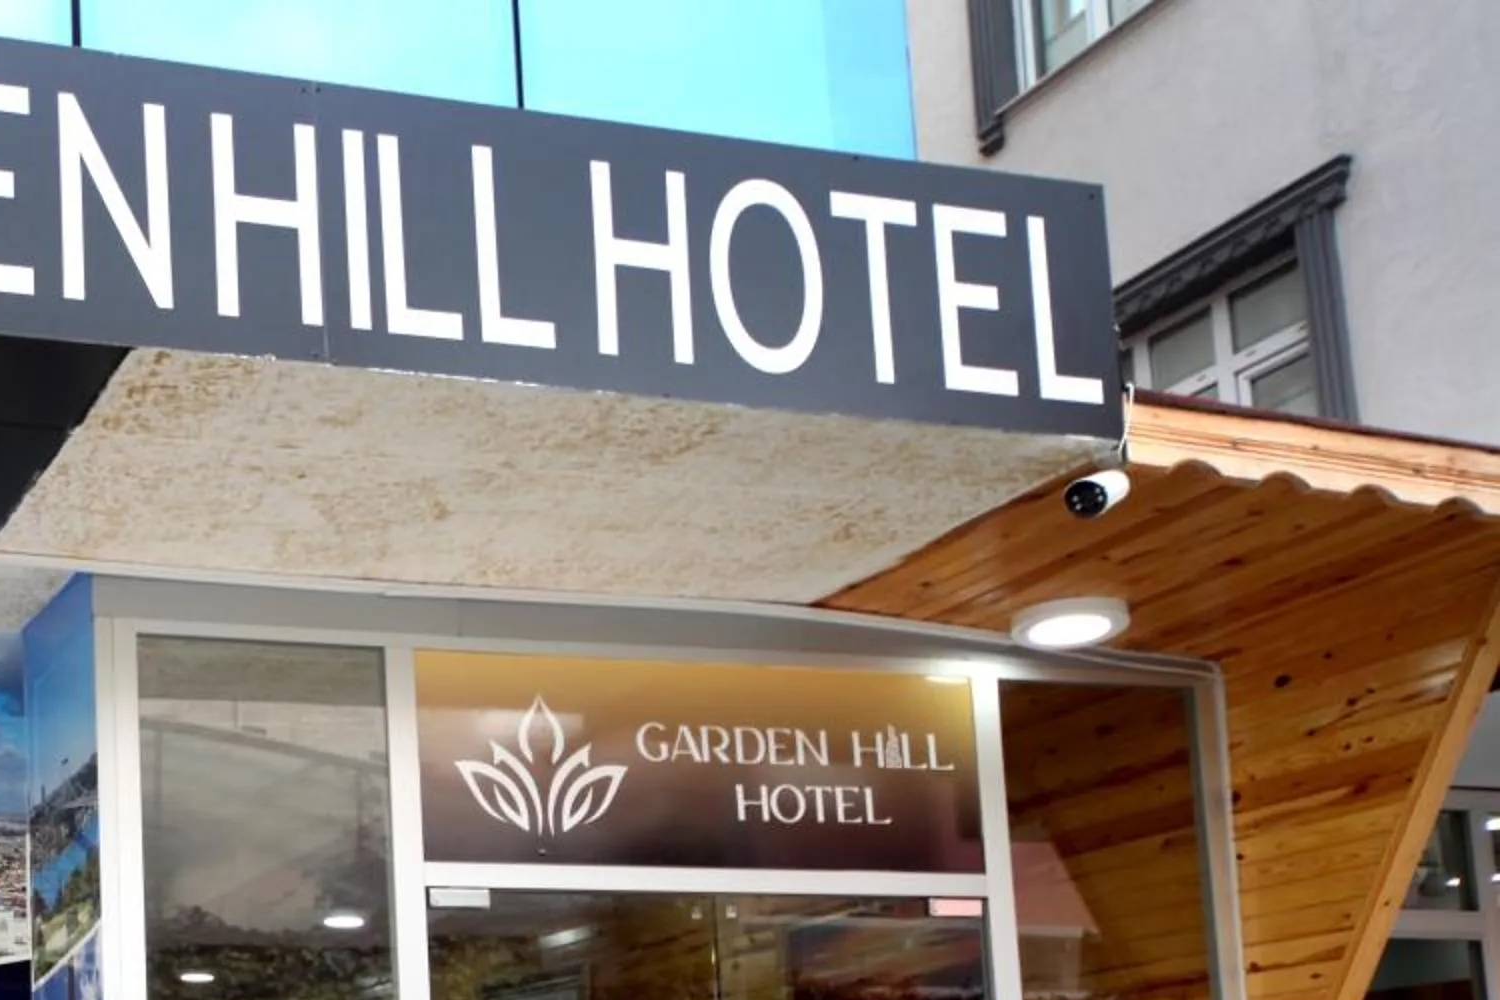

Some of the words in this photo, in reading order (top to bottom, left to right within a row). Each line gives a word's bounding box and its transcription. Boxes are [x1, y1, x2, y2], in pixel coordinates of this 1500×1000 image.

[210, 111, 557, 350] HILL
[589, 159, 1105, 406] HOTEL
[634, 721, 829, 768] GARDEN
[851, 724, 954, 772] HILL
[735, 783, 893, 826] HOTEL
